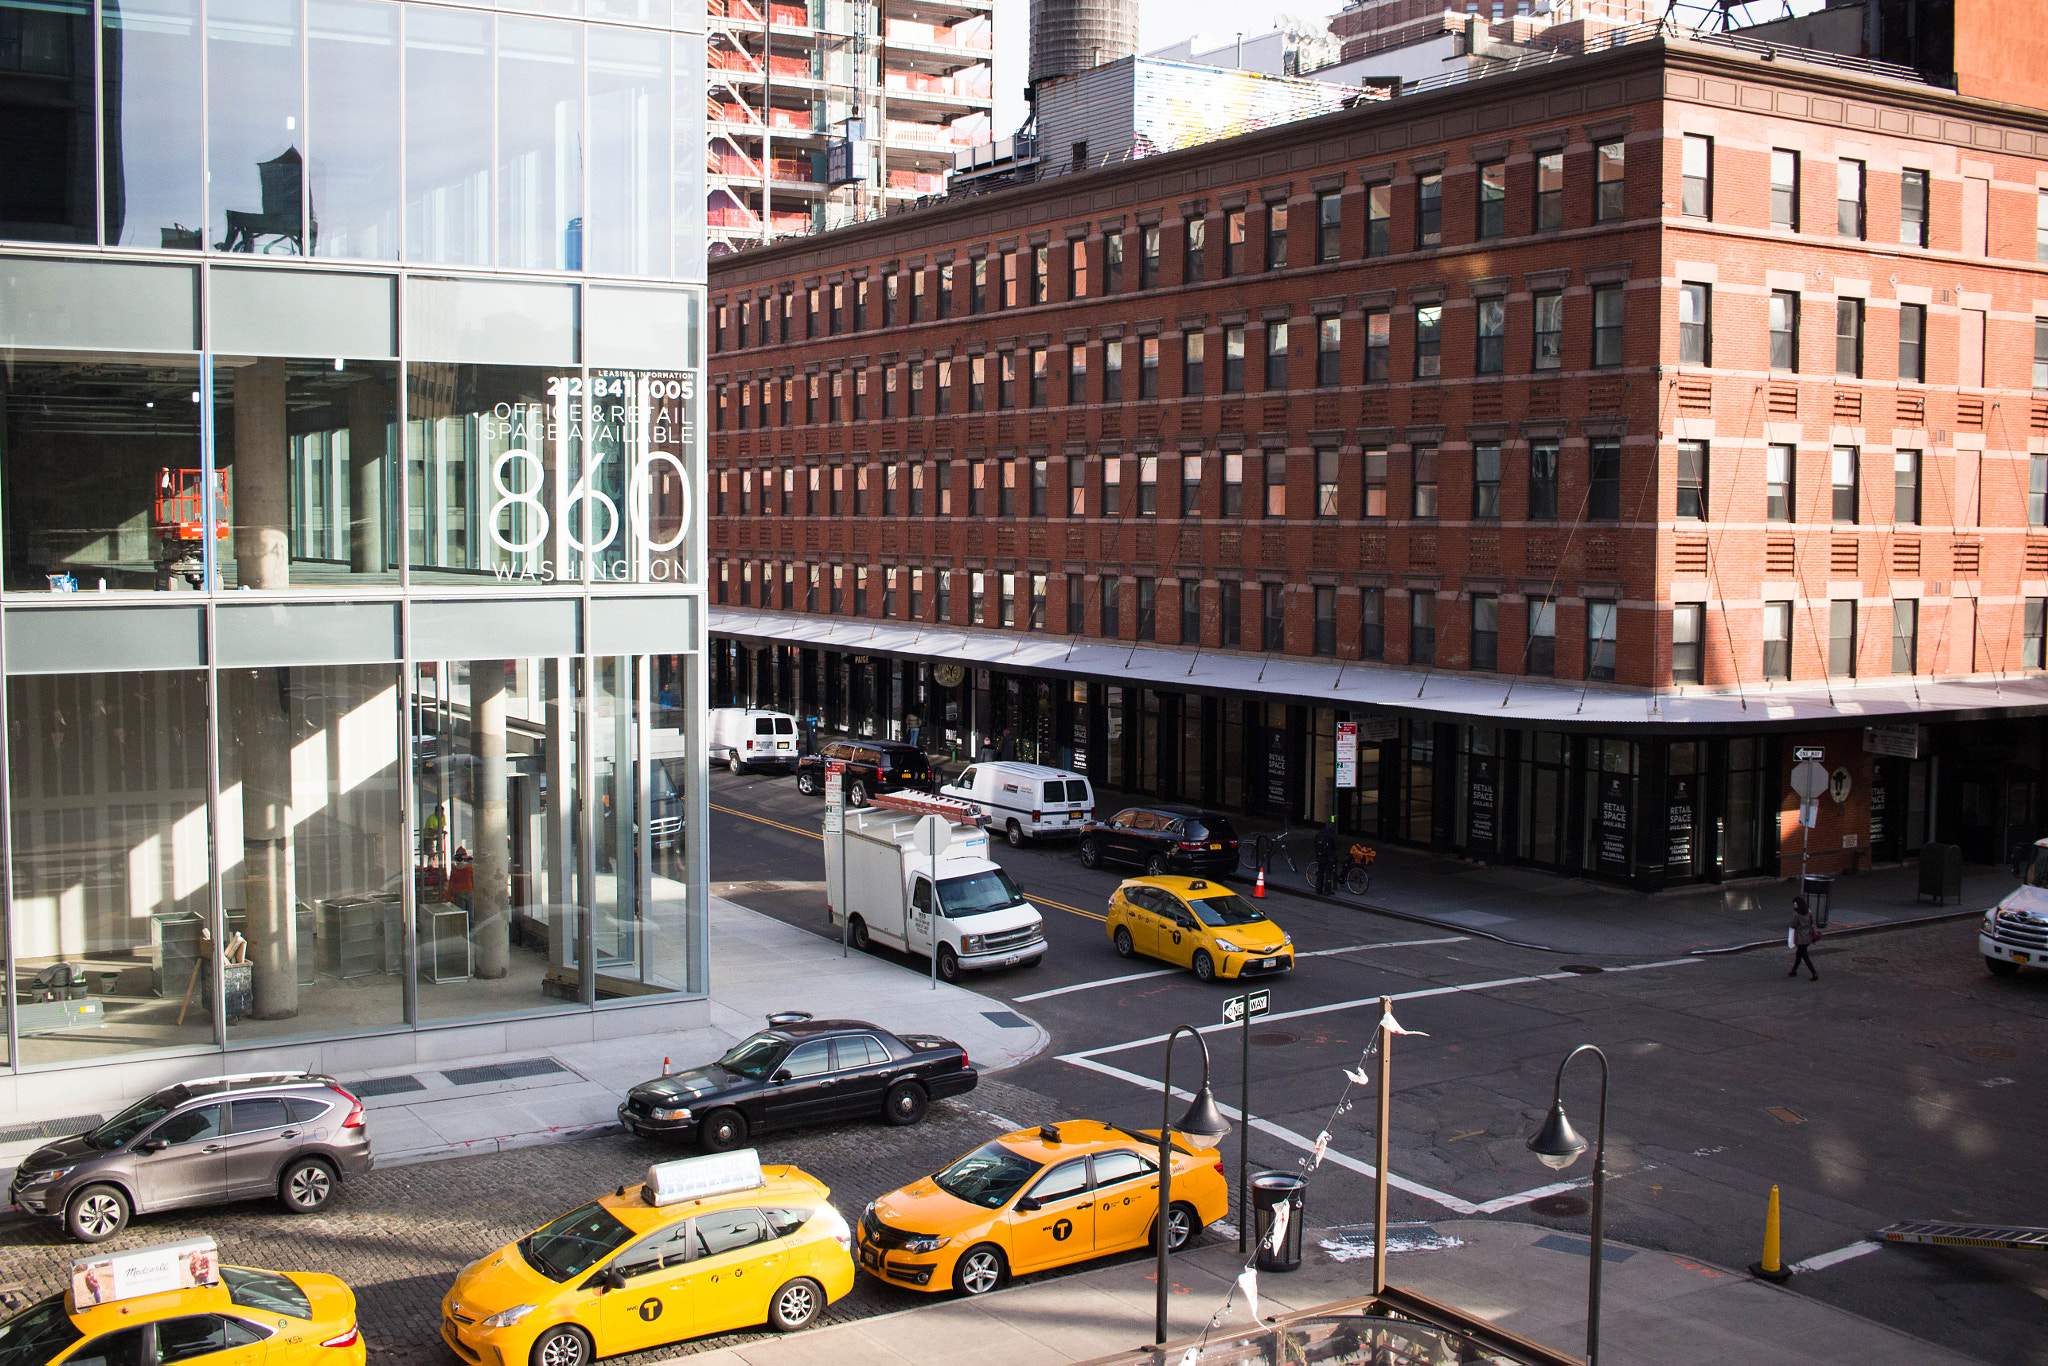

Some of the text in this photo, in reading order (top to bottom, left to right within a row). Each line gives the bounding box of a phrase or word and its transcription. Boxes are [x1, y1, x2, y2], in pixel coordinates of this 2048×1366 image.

[598, 370, 694, 379] LEASING INFORMATION
[547, 377, 694, 399] 212.841.005
[591, 405, 606, 422] &
[484, 423, 557, 441] SPACE
[489, 449, 692, 552] 860
[855, 656, 869, 664] PAIGE
[946, 665, 957, 678] NYC
[1269, 754, 1285, 762] RETAIL
[1269, 761, 1285, 769] SPACE
[1473, 784, 1493, 793] RETAIL
[1473, 792, 1493, 801] SPACE
[1603, 802, 1627, 813] RETAIL
[1670, 806, 1692, 814] RETAIL
[1603, 811, 1627, 822] SPACE
[1670, 814, 1692, 823] SPACE
[1602, 820, 1627, 829] AVAILABLE
[1669, 823, 1692, 831] AVAILABLE
[1229, 998, 1266, 1016] ONE WAY
